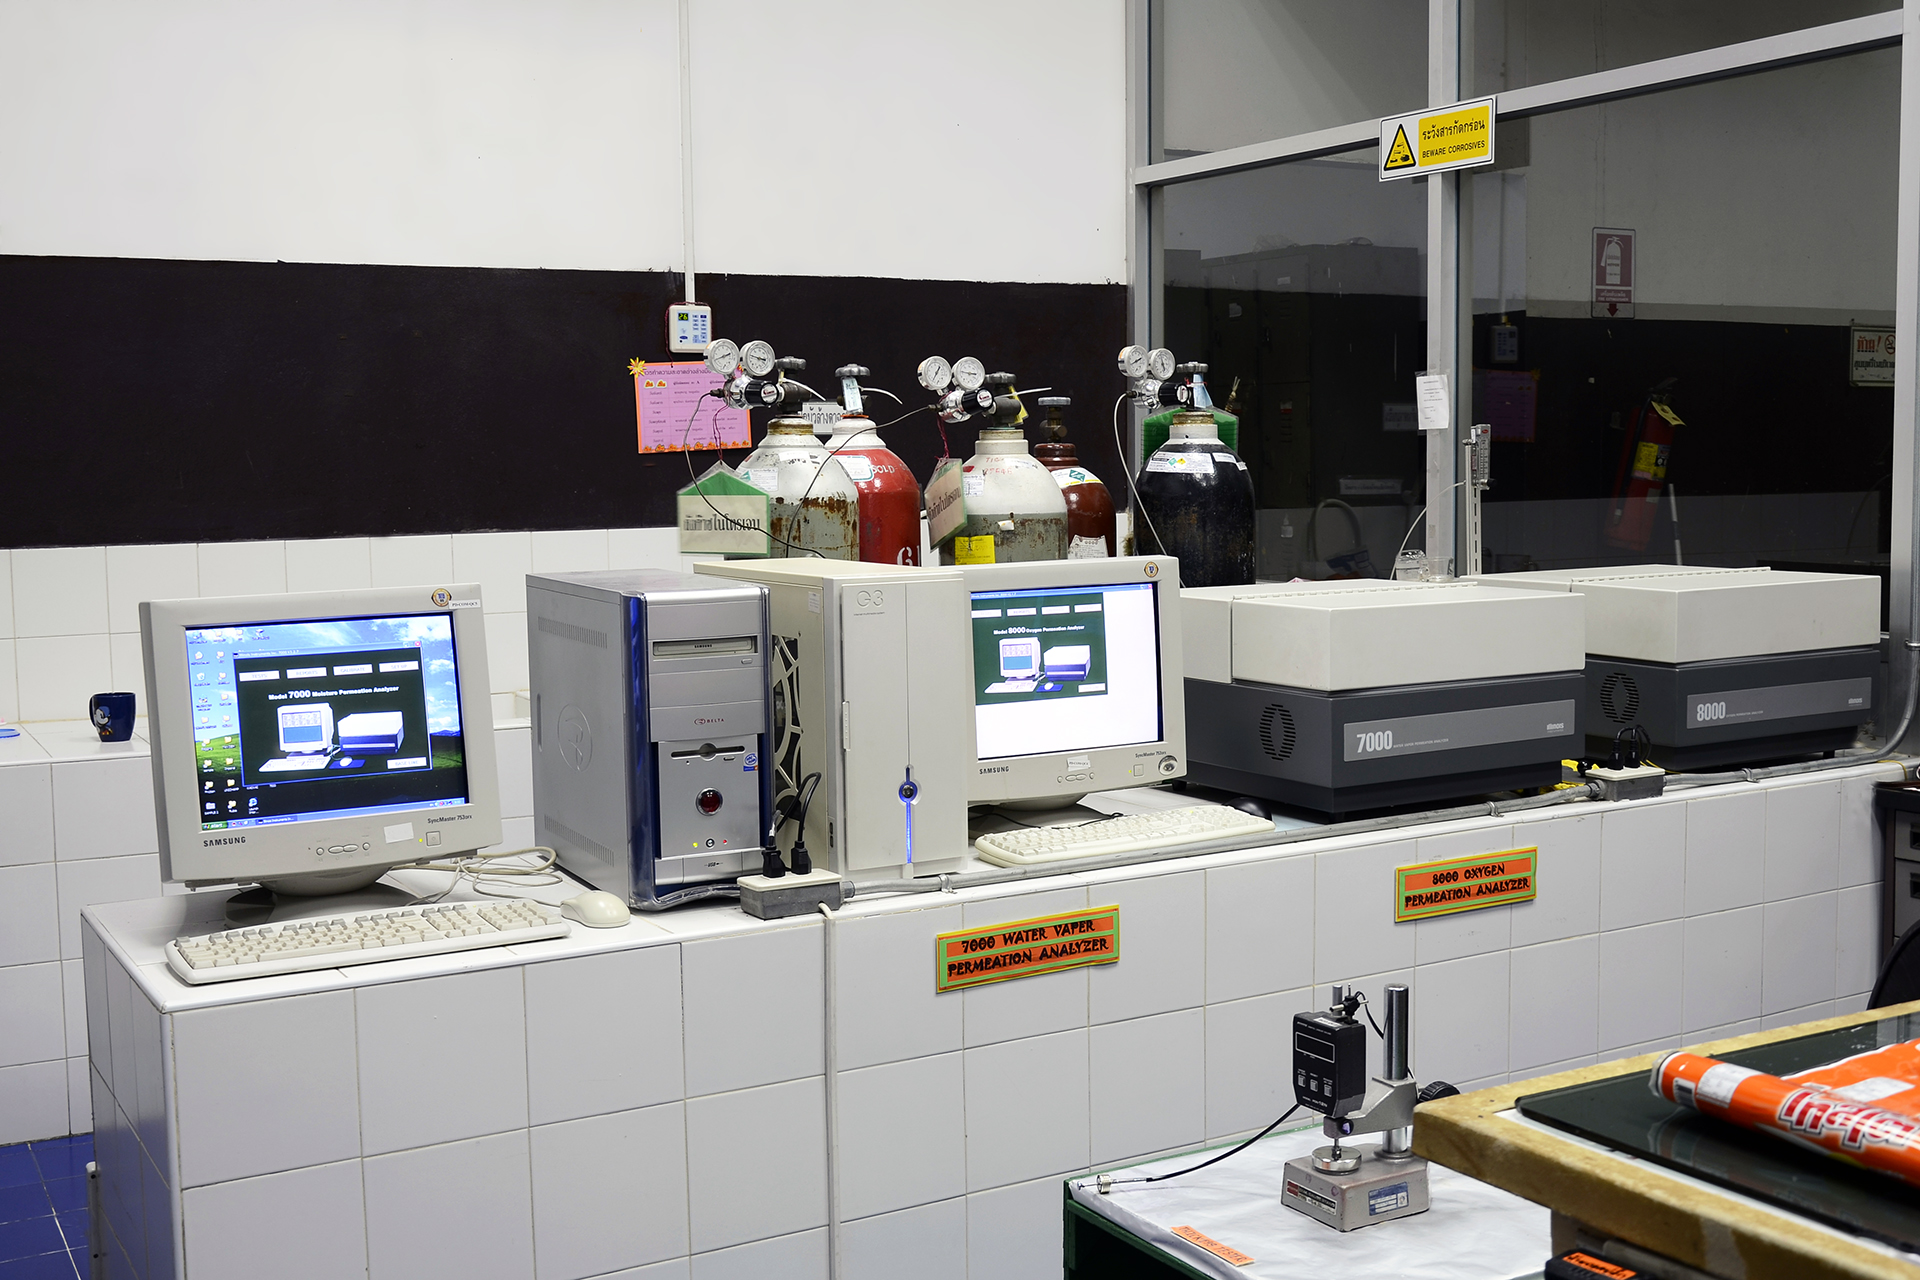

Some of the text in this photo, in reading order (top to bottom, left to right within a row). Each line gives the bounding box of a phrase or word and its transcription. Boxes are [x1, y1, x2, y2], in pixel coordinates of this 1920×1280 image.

[1422, 117, 1485, 140] ระวังสารกัดกร่อน
[1422, 140, 1485, 158] BEWARE CORROSIVES
[857, 590, 883, 608] G3
[288, 690, 311, 699] 7000
[339, 687, 372, 695] Permeation
[1697, 701, 1726, 722] 8000
[1356, 730, 1392, 753] 7000
[979, 765, 1010, 774] SAMSUNG
[427, 816, 456, 824] SyncMaster
[203, 836, 246, 847] SAMSUNG
[1432, 863, 1505, 885] 8000 OXYGEN
[1405, 878, 1529, 908] PERMEATION ANALYZER
[961, 919, 1095, 953] 7000 WATER VAPER
[947, 938, 1109, 977] PERMEATION ANALYZER
